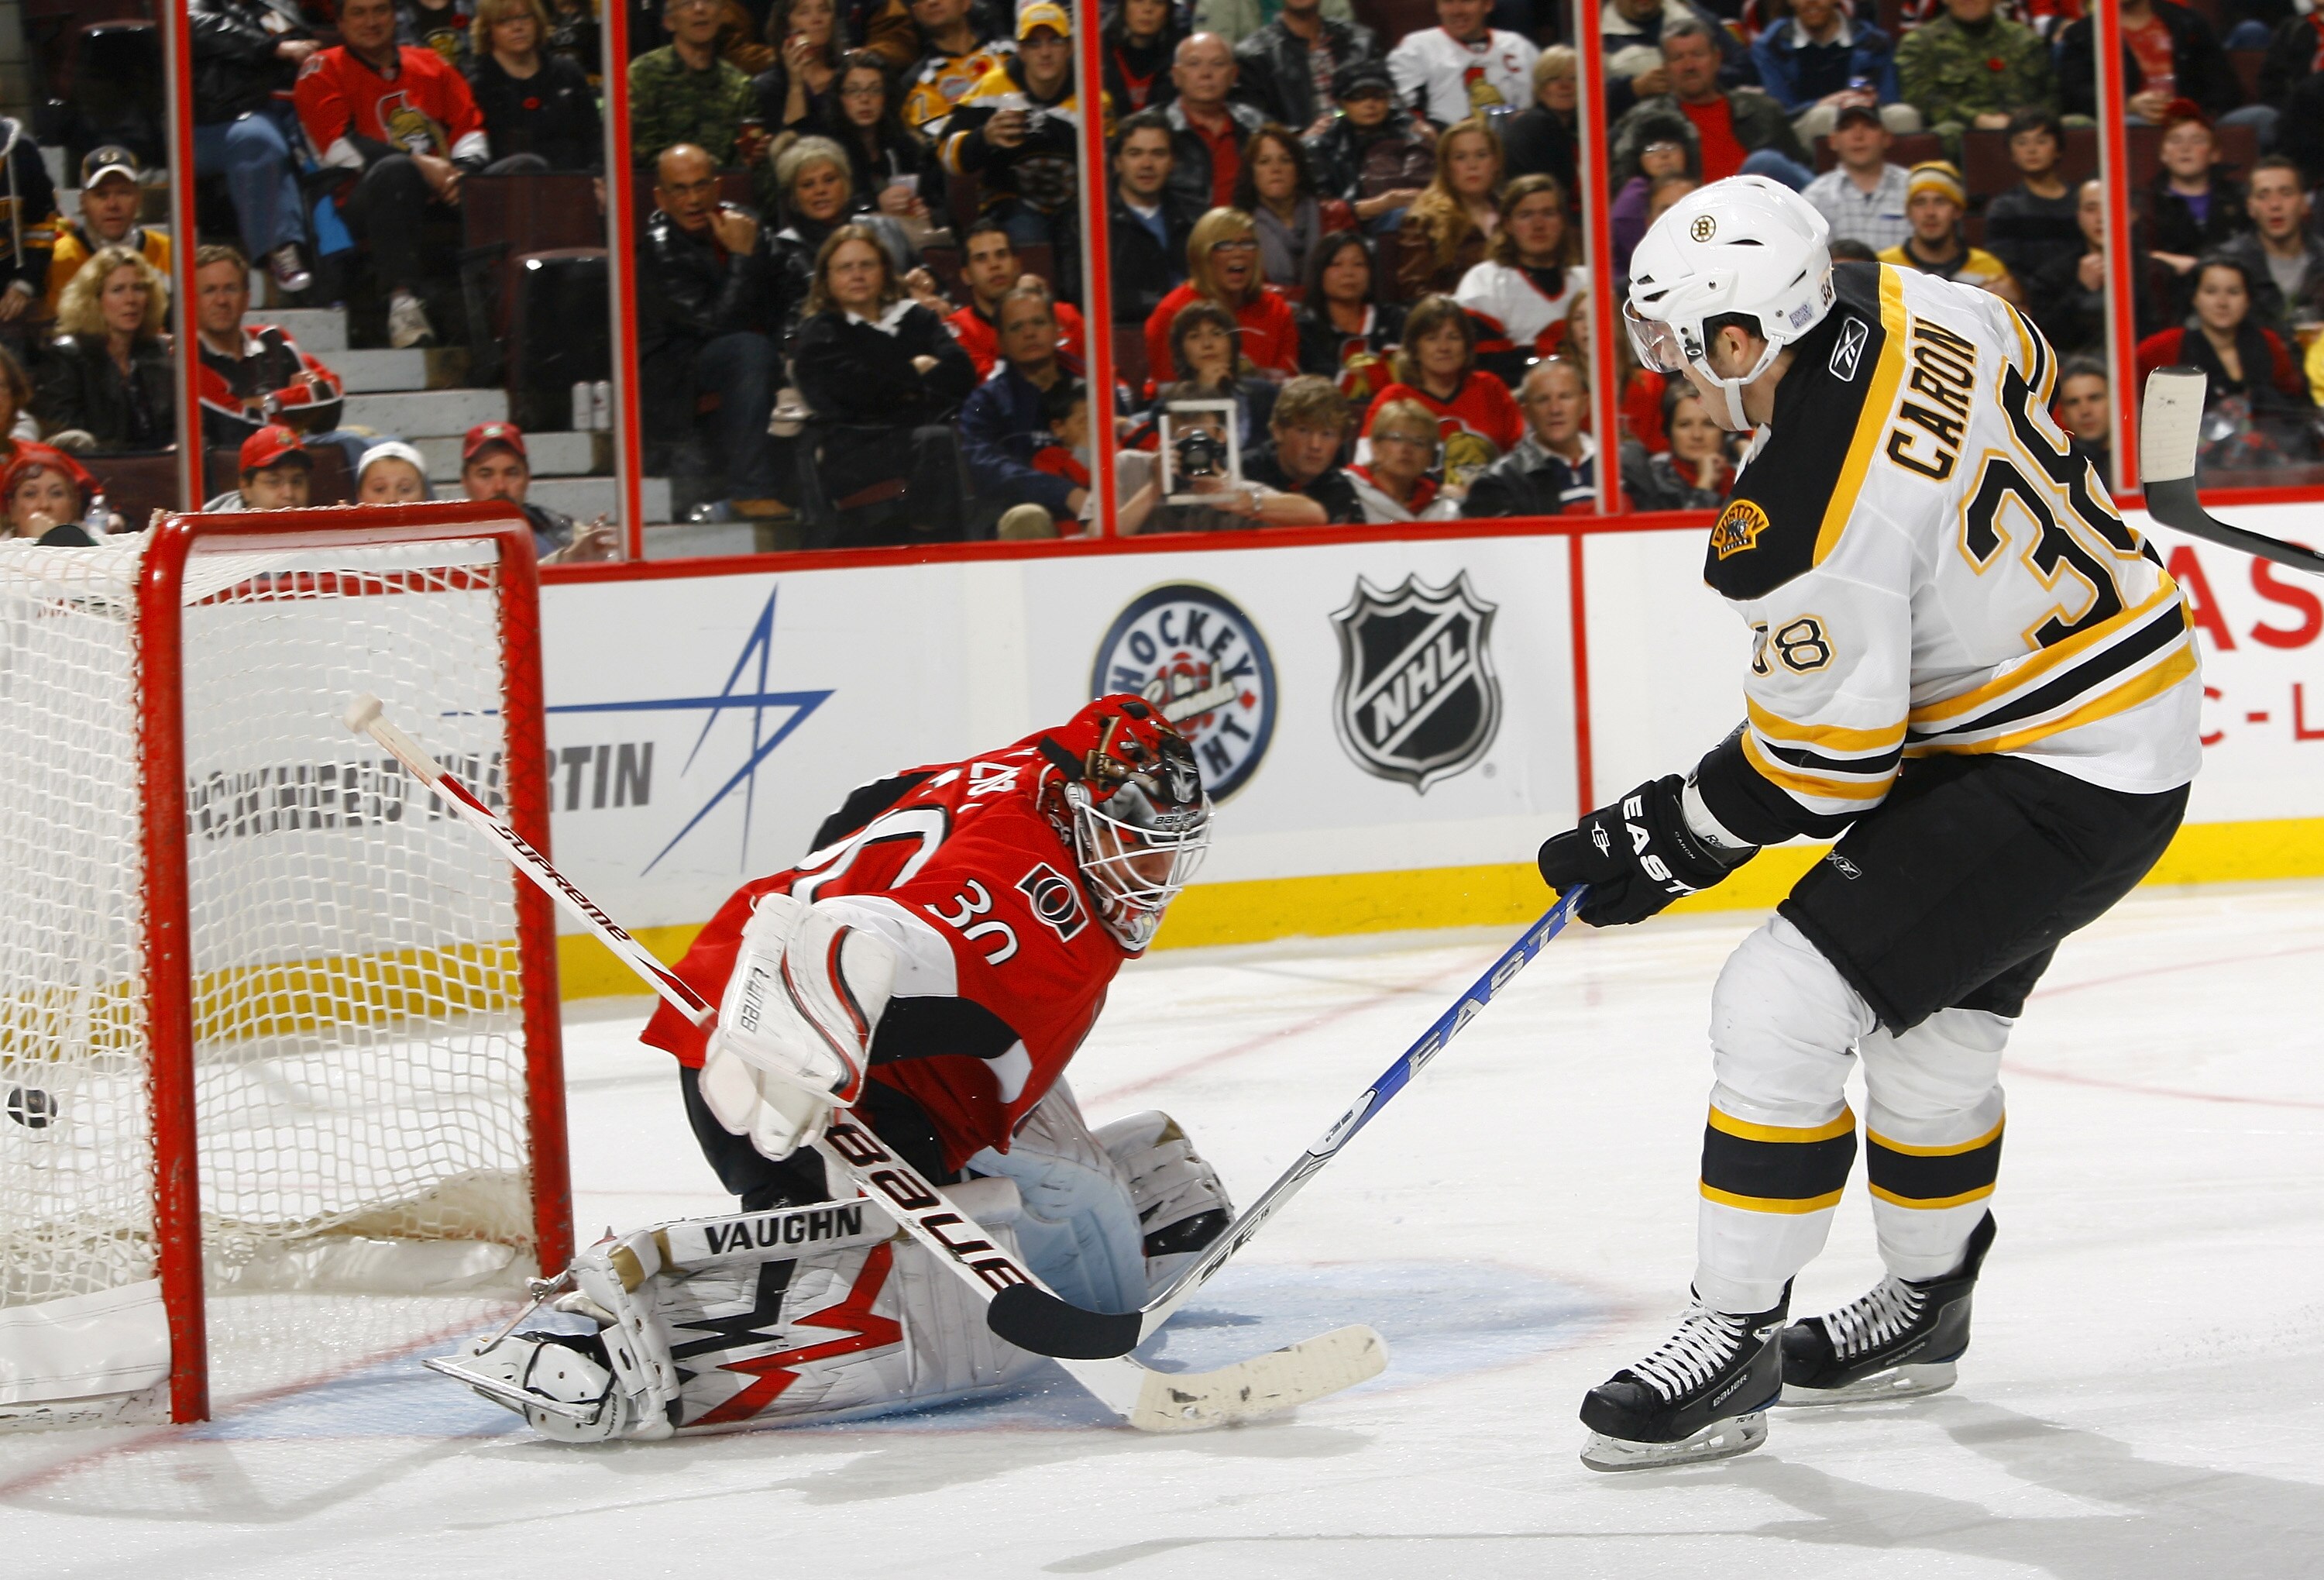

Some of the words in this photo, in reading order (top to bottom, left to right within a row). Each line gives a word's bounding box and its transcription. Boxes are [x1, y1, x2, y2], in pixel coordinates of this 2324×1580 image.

[1883, 314, 1979, 484] CARON
[1109, 608, 1257, 696] HOCKEY
[1371, 628, 1468, 744] NHL
[1622, 794, 1698, 897] EAST
[704, 1205, 862, 1255] VAUGHN
